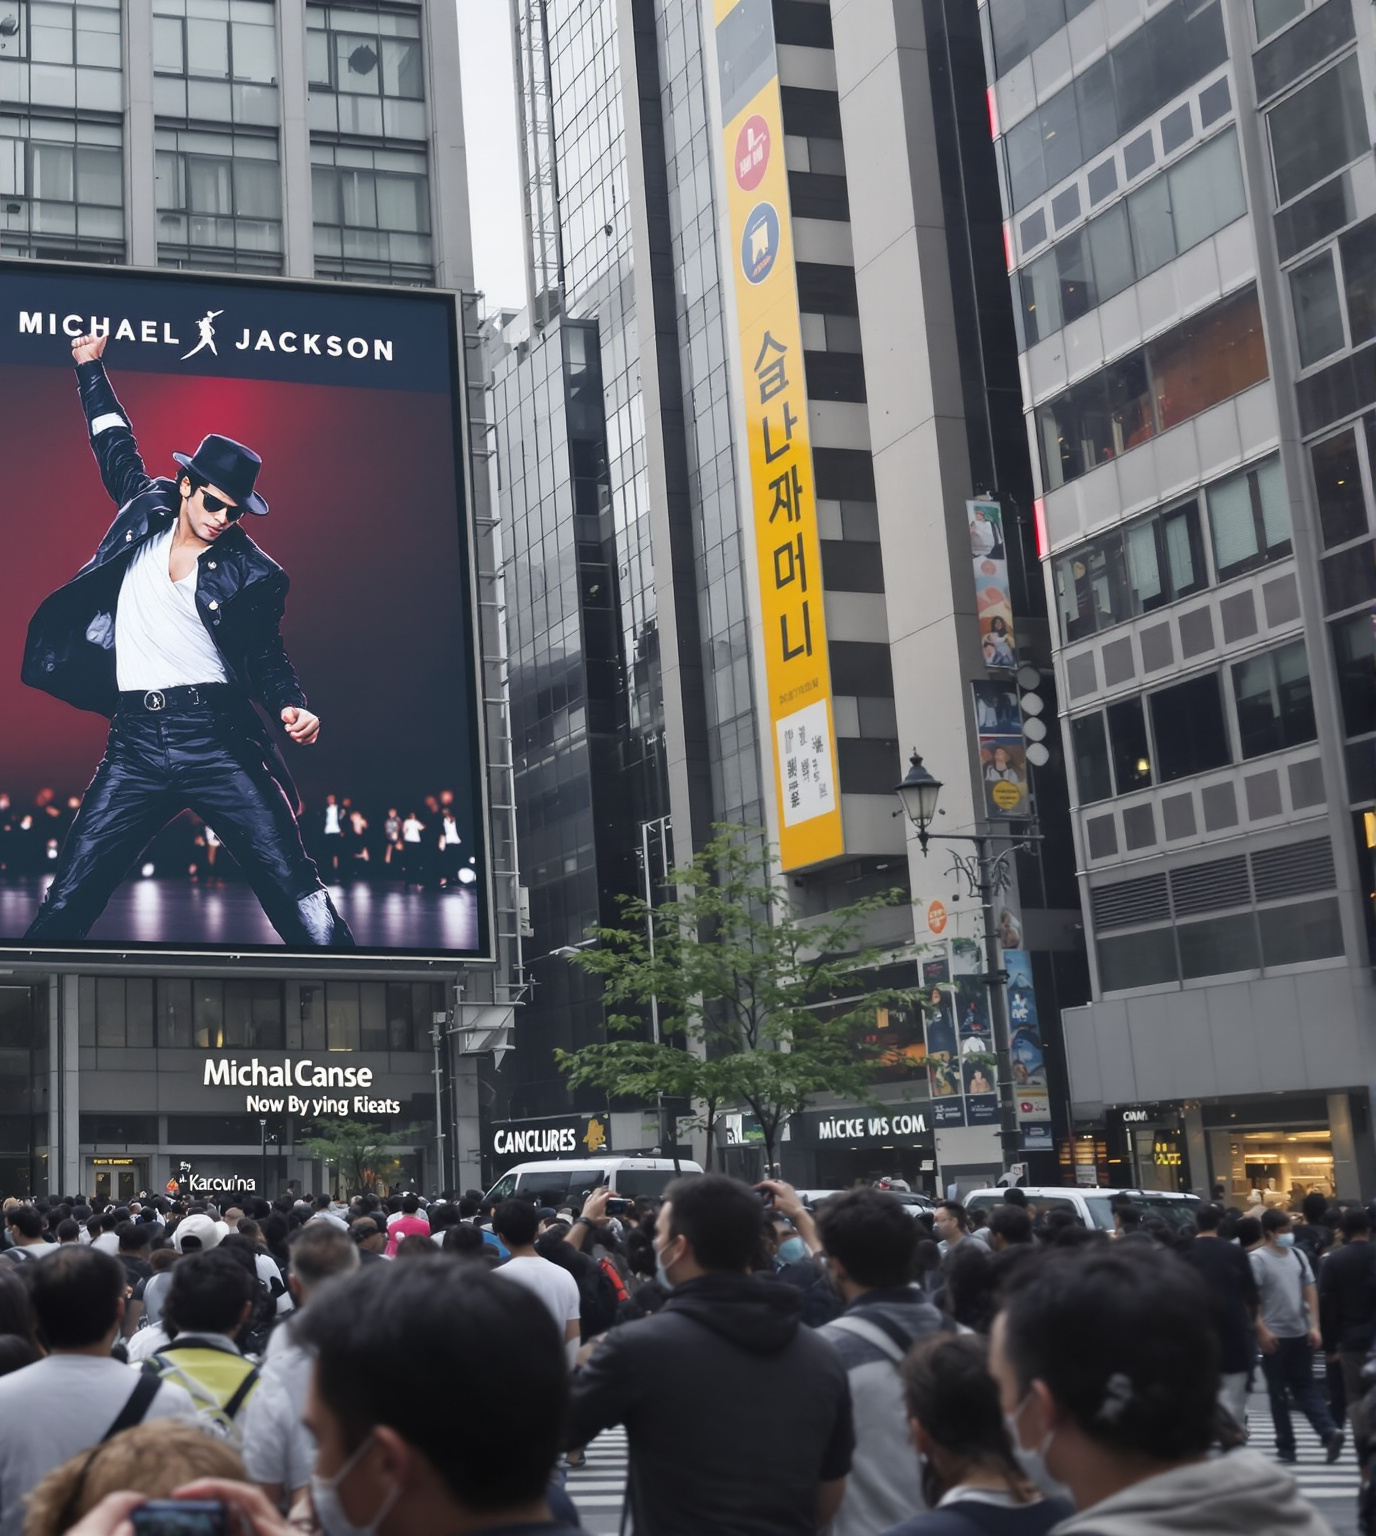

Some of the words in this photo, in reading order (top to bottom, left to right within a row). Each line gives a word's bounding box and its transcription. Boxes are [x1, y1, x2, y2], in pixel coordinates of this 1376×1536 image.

[18, 311, 180, 345] MICHAEL
[235, 328, 394, 361] JACKSON
[203, 1058, 293, 1087] Michal
[295, 1059, 373, 1088] Canse
[246, 1095, 284, 1113] Now
[288, 1095, 309, 1117] By
[313, 1096, 349, 1117] ying
[494, 1128, 576, 1154] CANCLURES
